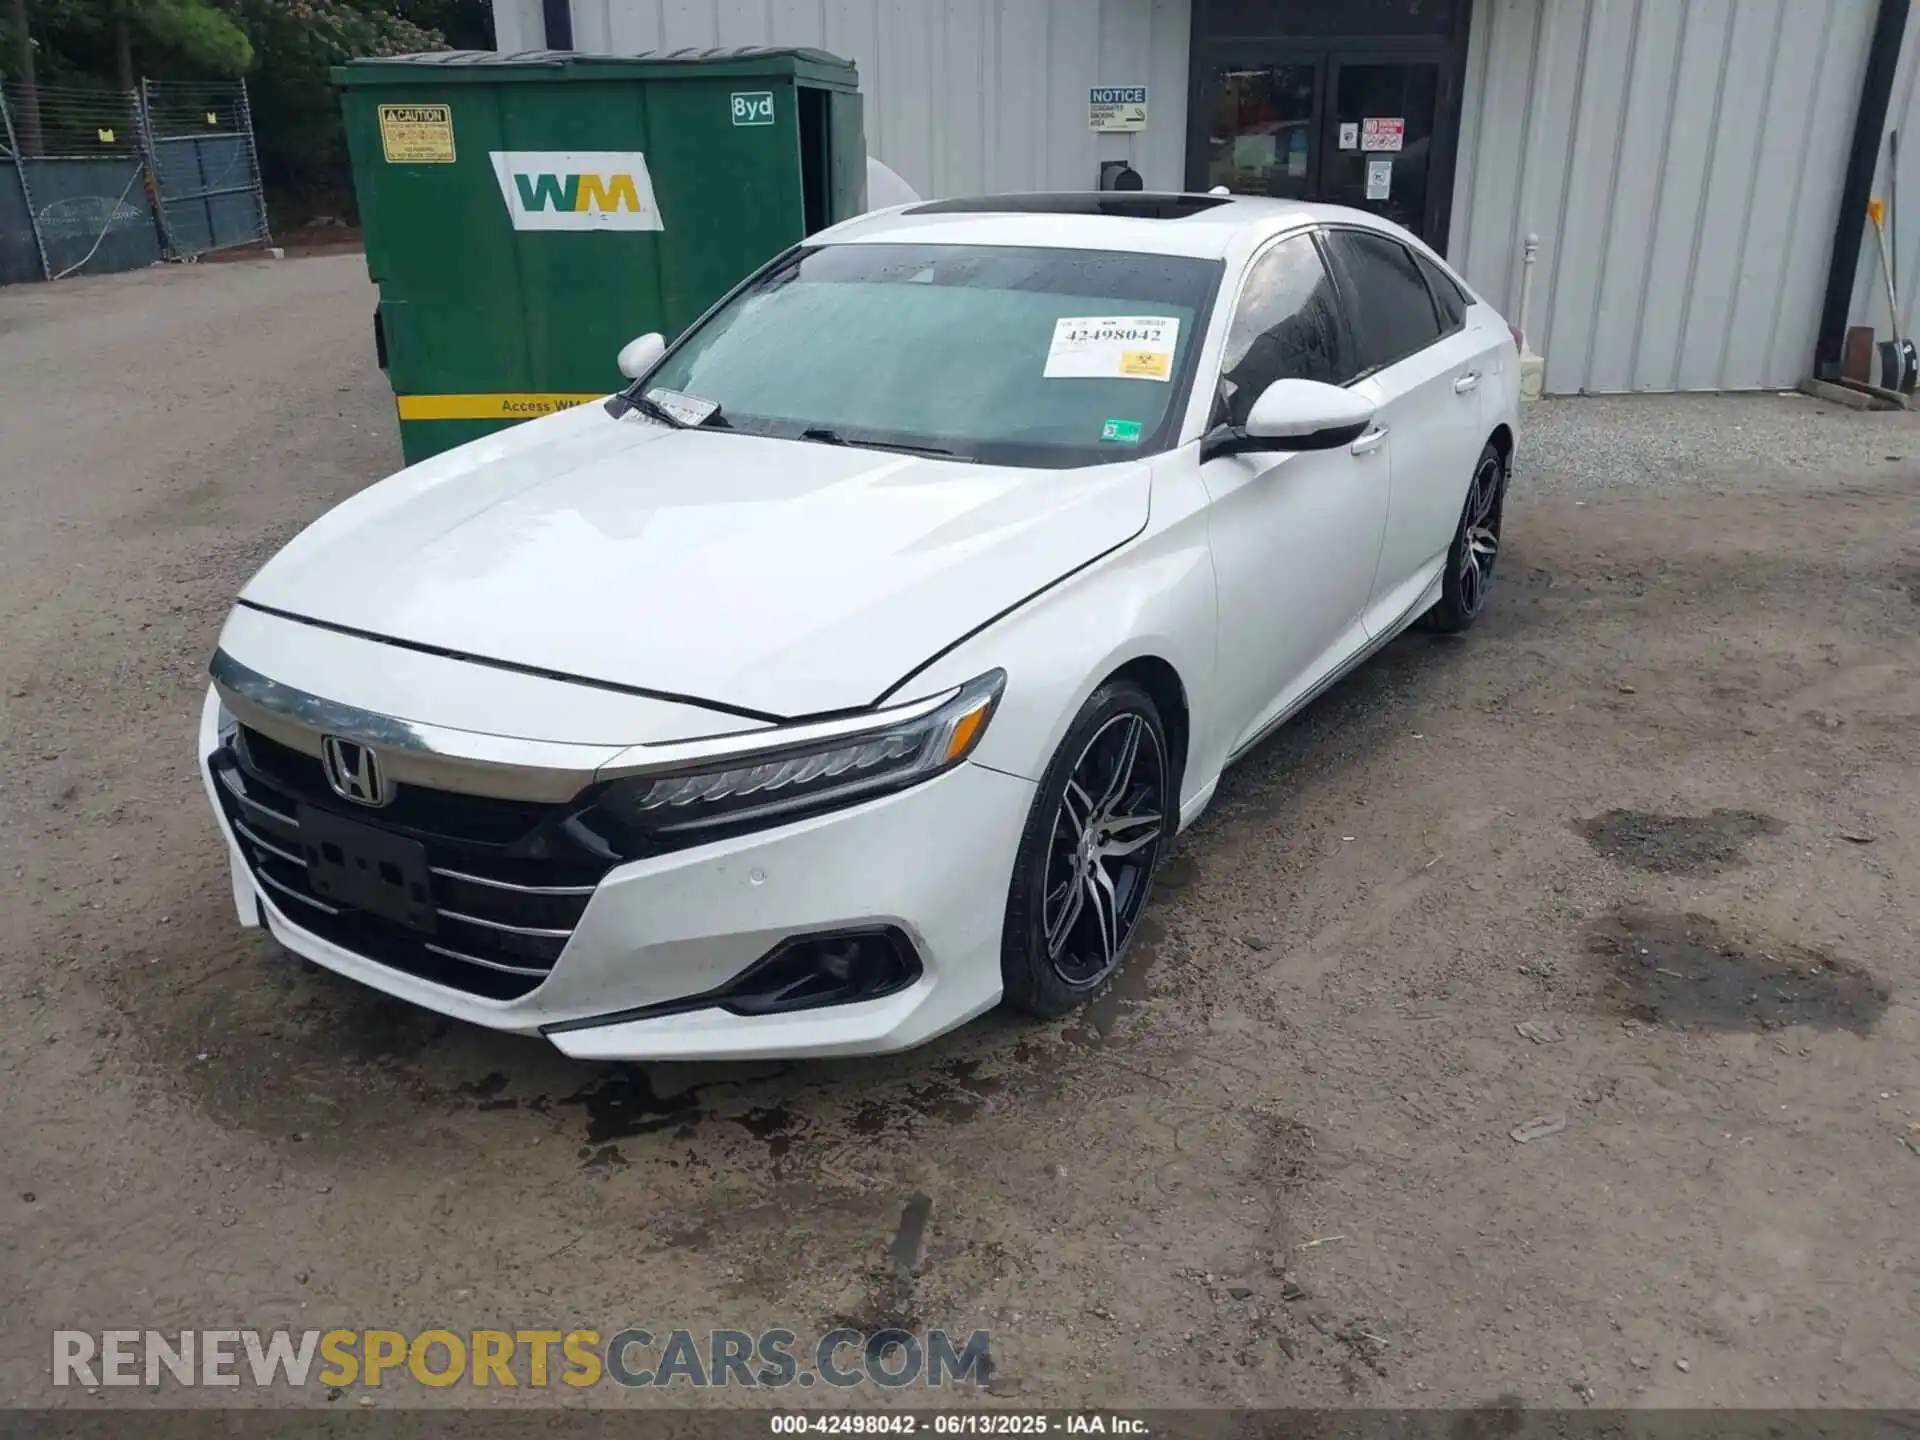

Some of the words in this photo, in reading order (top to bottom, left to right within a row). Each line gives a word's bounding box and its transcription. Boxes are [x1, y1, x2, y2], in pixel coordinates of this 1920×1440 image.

[1093, 90, 1143, 102] NOTICE
[734, 96, 772, 120] 8yd
[398, 110, 441, 121] CAUTION
[513, 173, 641, 212] WM
[1065, 329, 1161, 341] 42498042
[502, 400, 550, 412] Access
